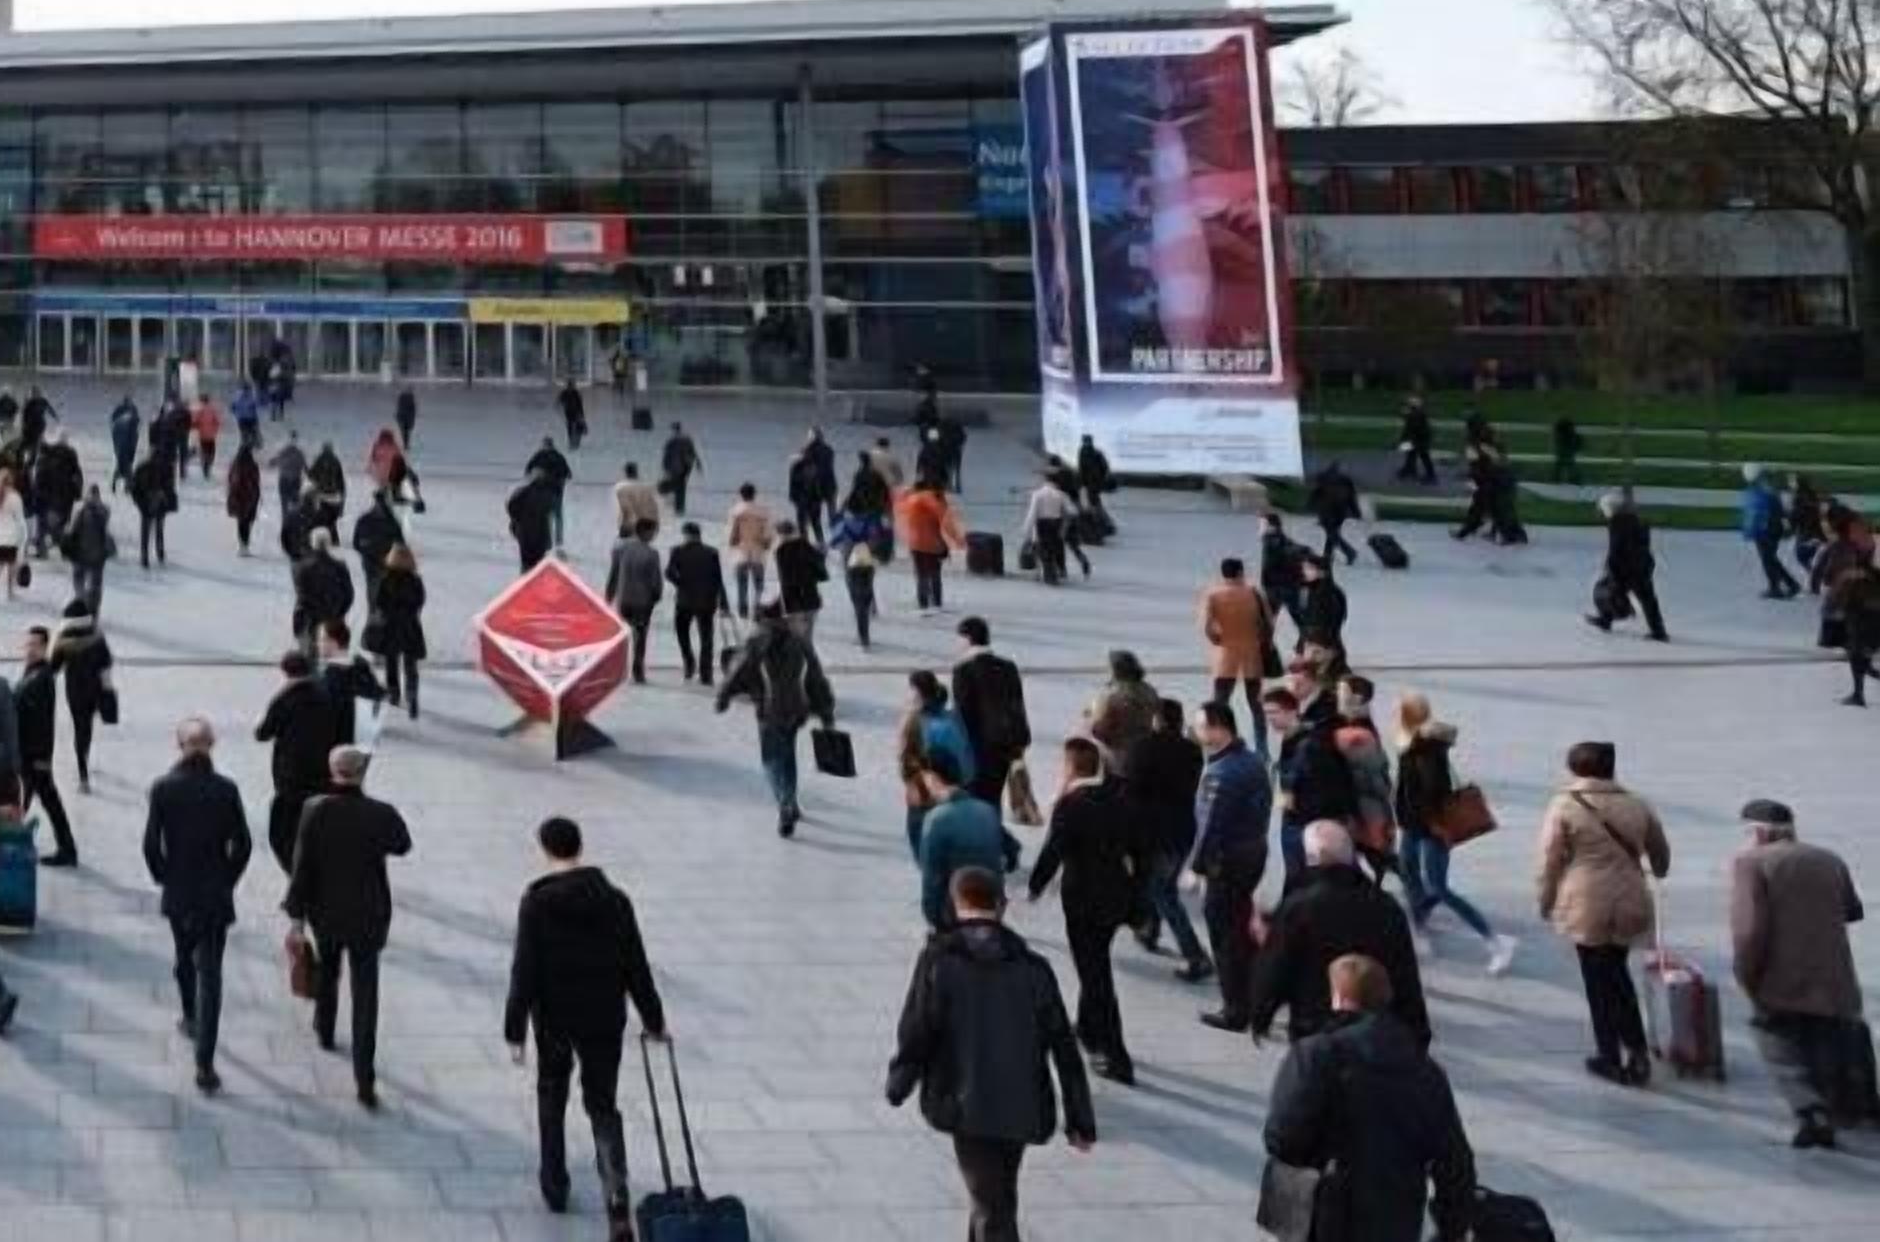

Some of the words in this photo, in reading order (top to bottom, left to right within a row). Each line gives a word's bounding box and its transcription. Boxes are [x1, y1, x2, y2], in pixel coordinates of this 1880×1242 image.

[205, 229, 228, 247] to
[236, 225, 369, 247] HANNOVER
[380, 226, 456, 247] MESSE
[467, 224, 521, 247] 2016
[1132, 348, 1265, 371] PARTNERSHIP
